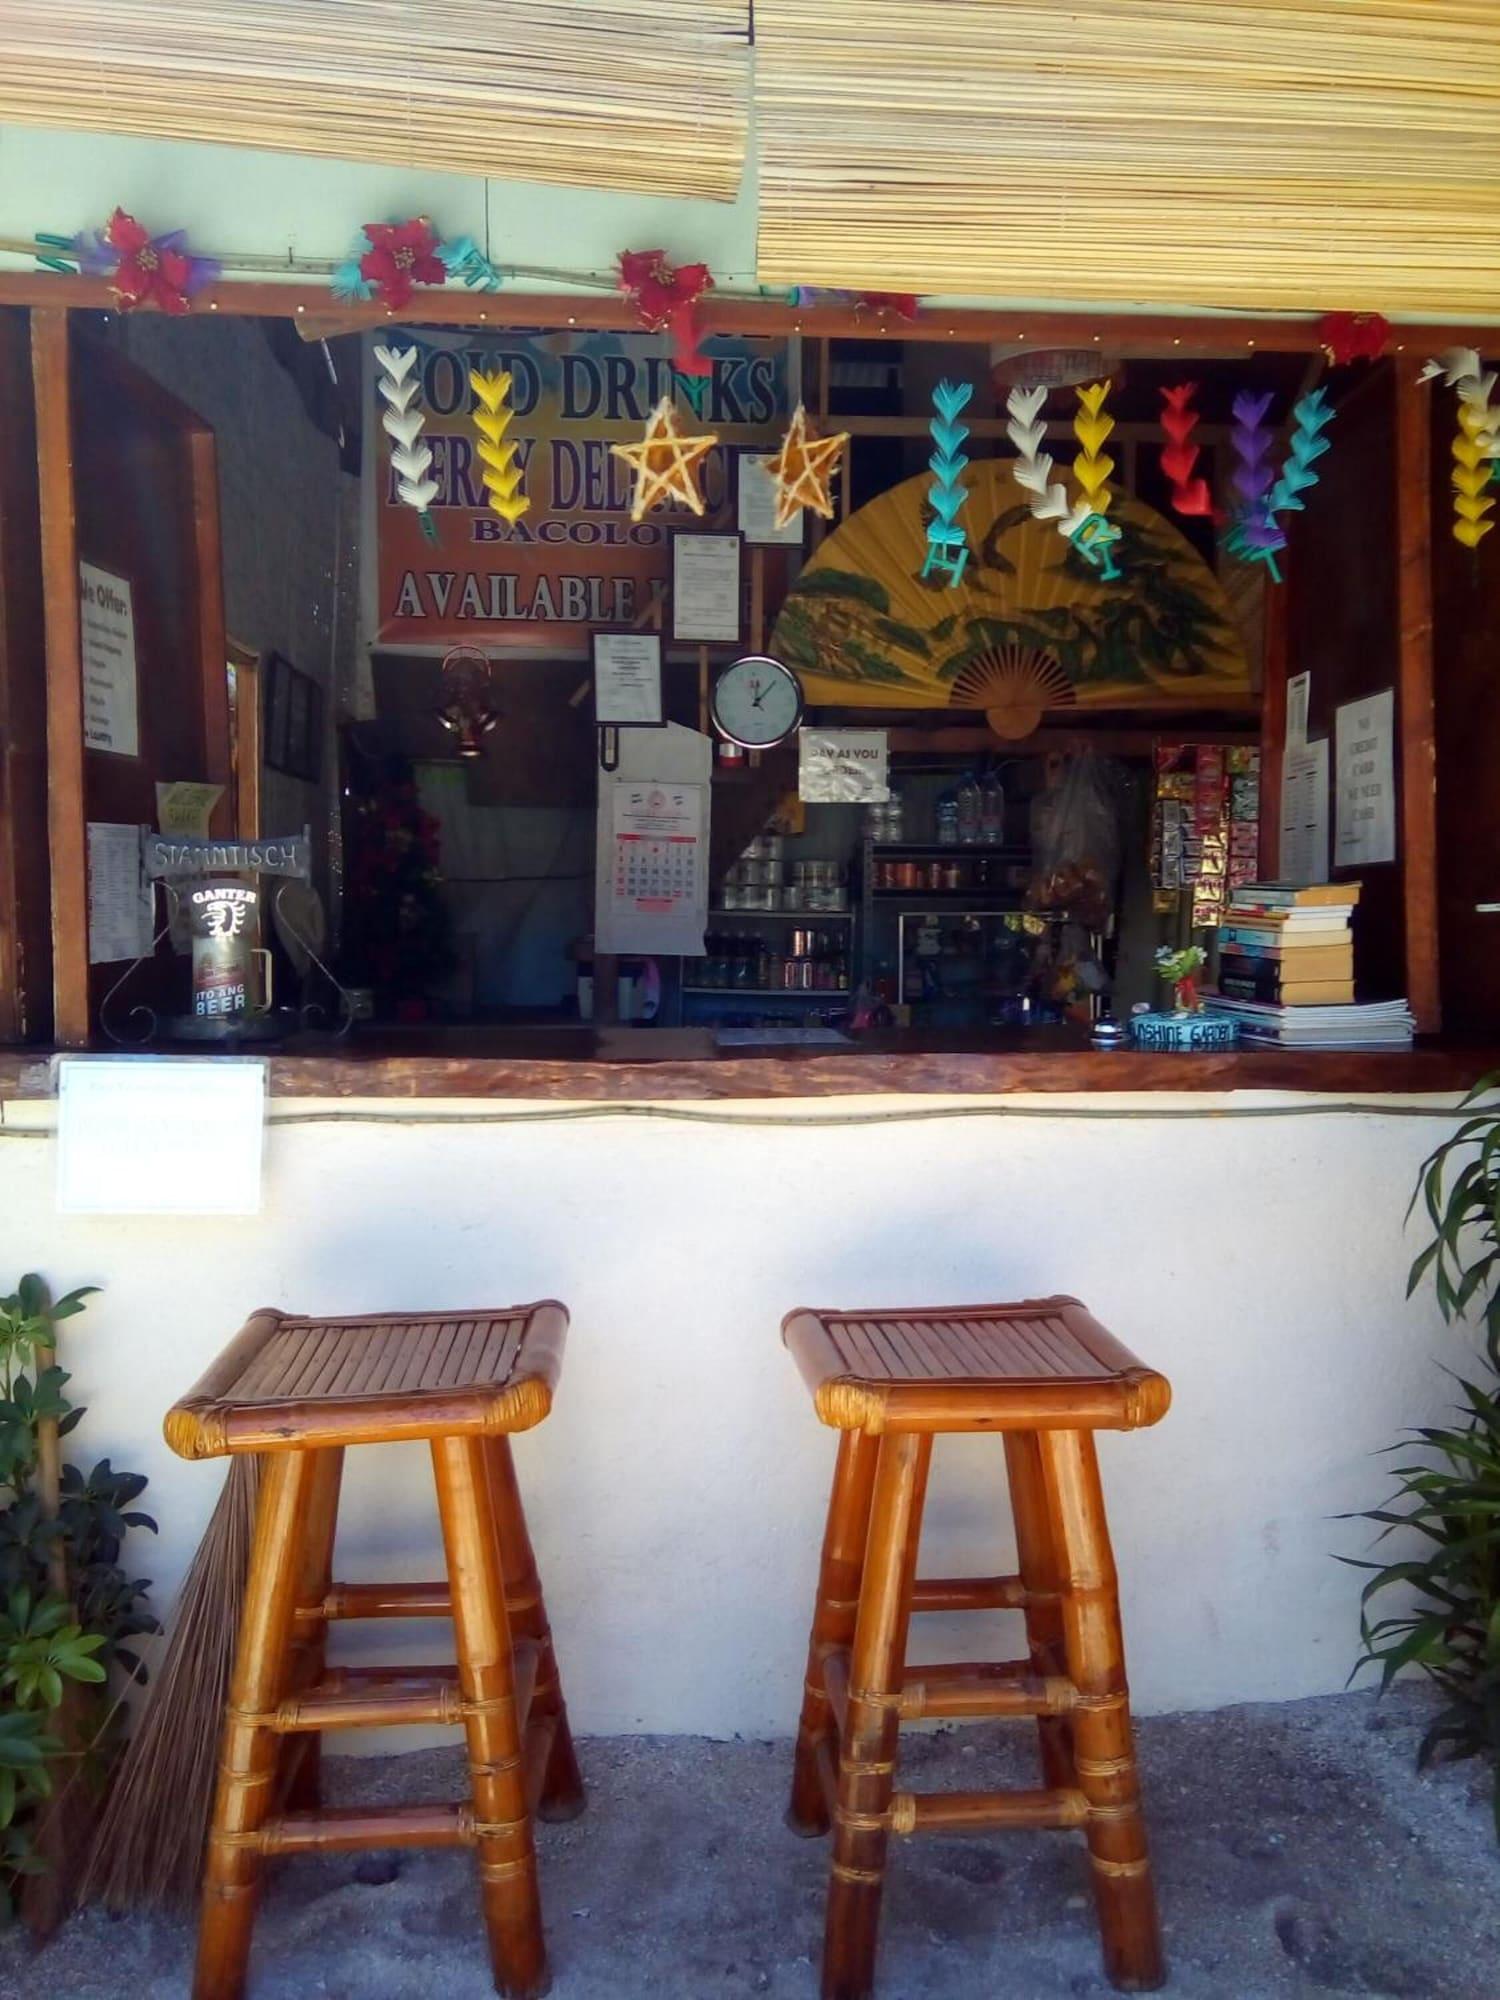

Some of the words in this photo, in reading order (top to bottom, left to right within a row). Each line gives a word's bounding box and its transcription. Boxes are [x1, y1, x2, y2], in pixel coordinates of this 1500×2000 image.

[393, 571, 635, 622] AVAILABLE
[154, 842, 297, 868] STAMMTISCH
[191, 888, 256, 904] GANTER
[196, 990, 215, 1001] ITO
[218, 984, 246, 999] ANG
[196, 994, 247, 1016] BEER
